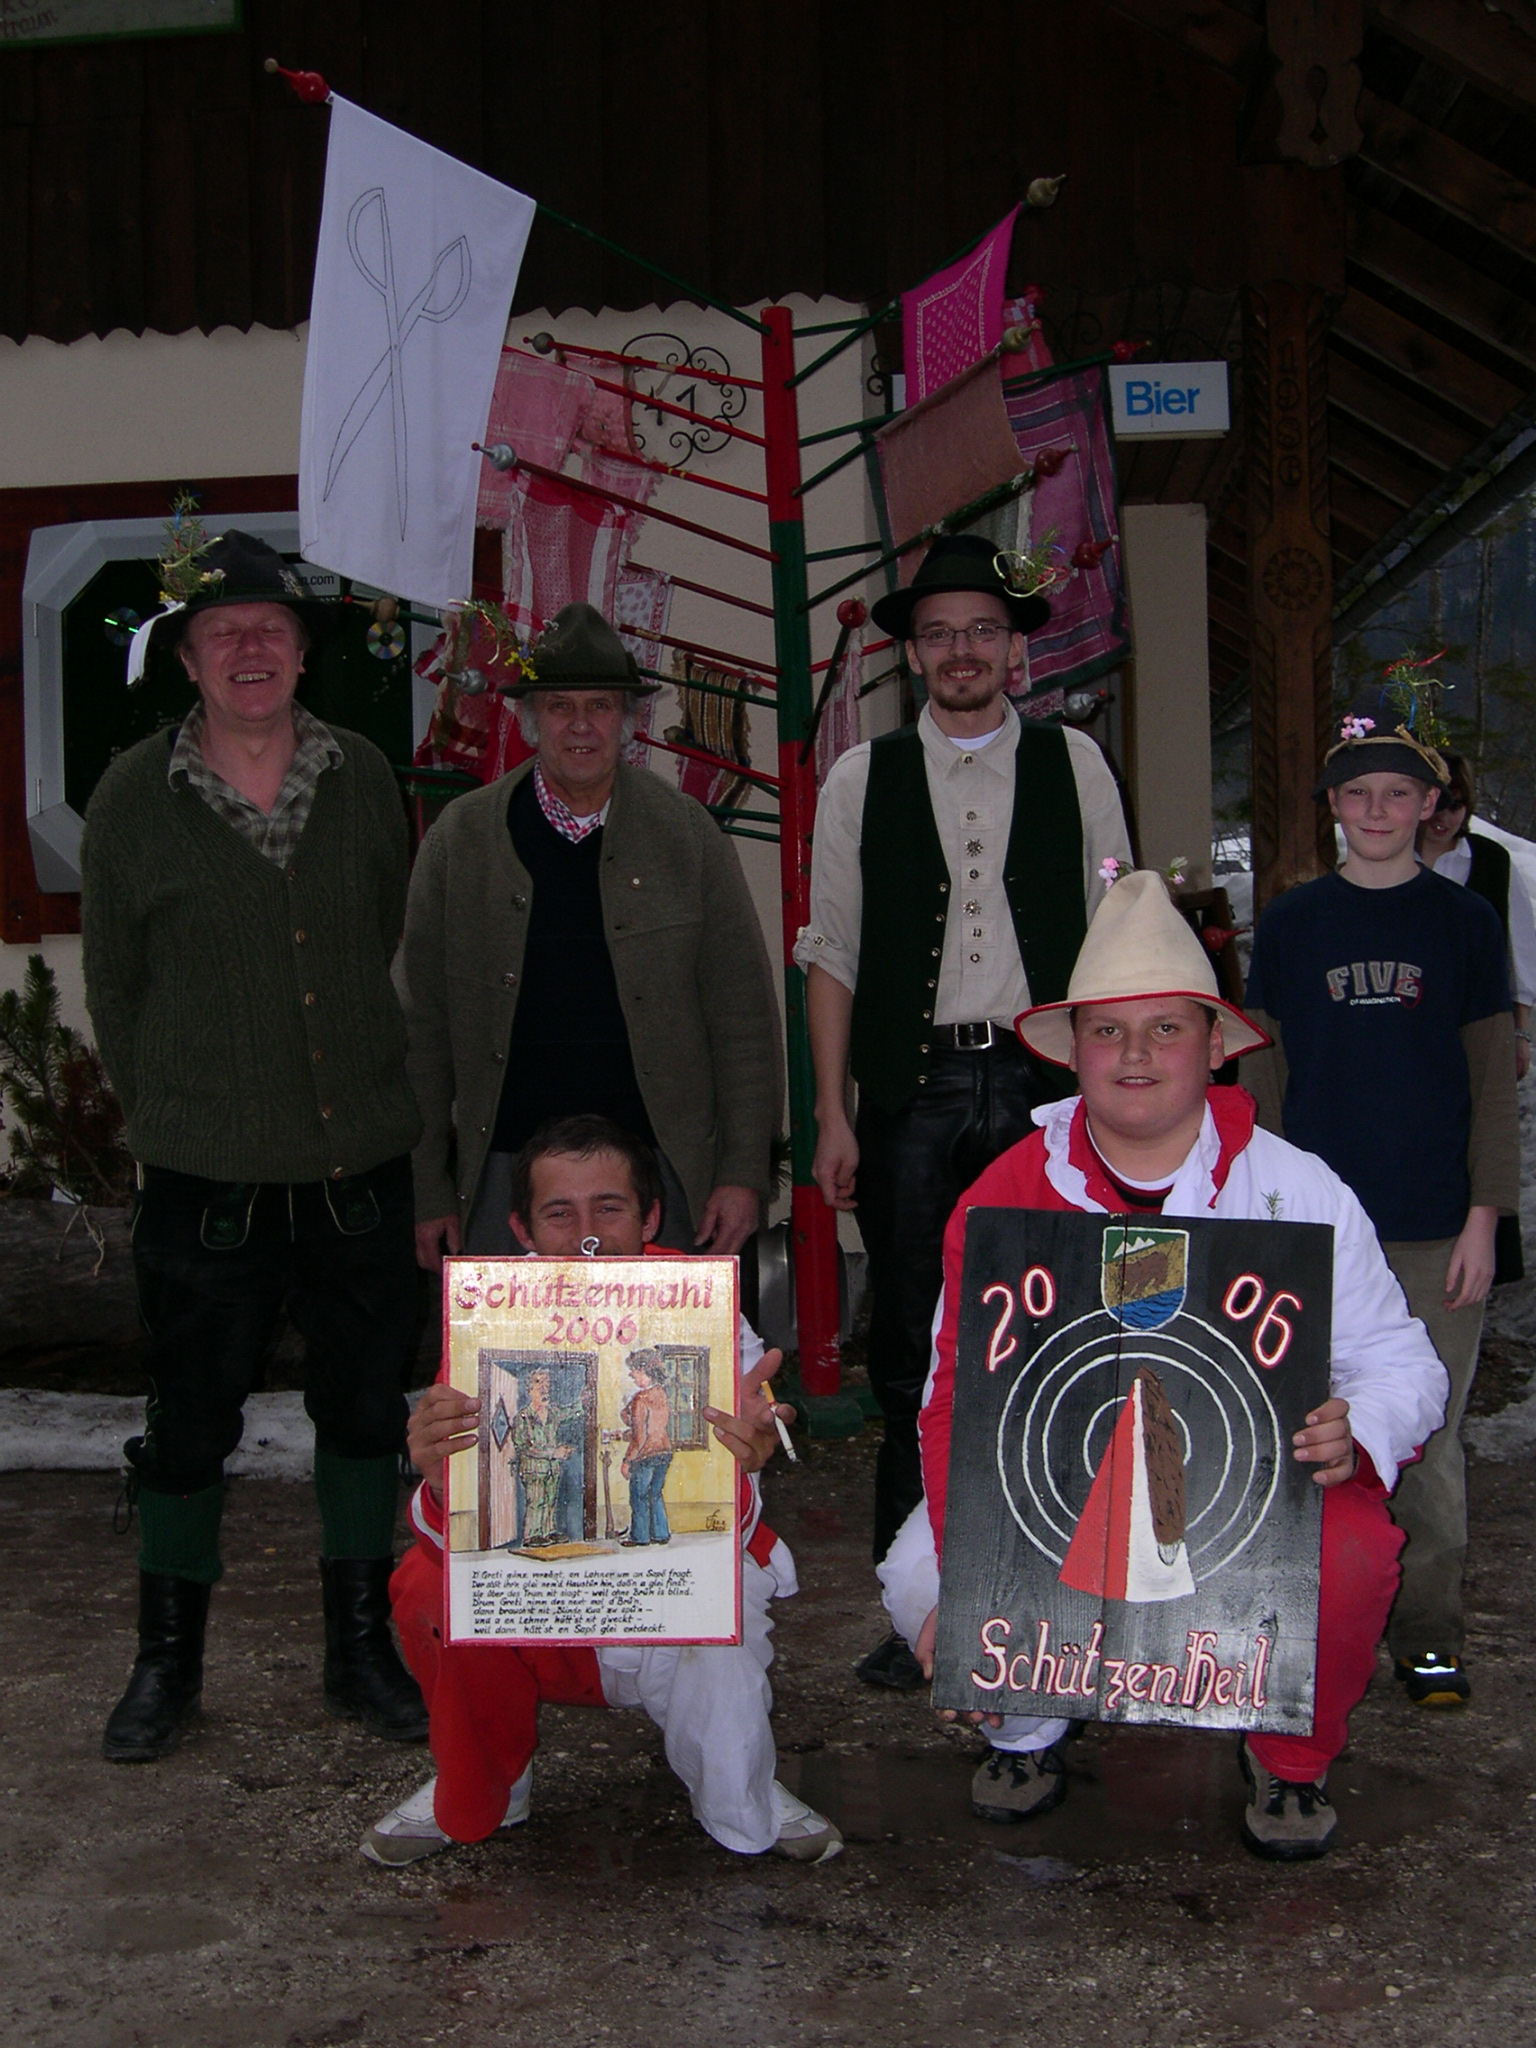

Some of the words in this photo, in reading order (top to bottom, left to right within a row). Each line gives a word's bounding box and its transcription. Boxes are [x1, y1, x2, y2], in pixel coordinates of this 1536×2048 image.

[1126, 381, 1201, 416] Bier
[1326, 960, 1423, 1002] FIVE
[455, 1273, 714, 1310] Schützenmahl
[543, 1312, 639, 1345] 2006
[982, 1263, 1057, 1372] 20
[1221, 1271, 1303, 1369] 06
